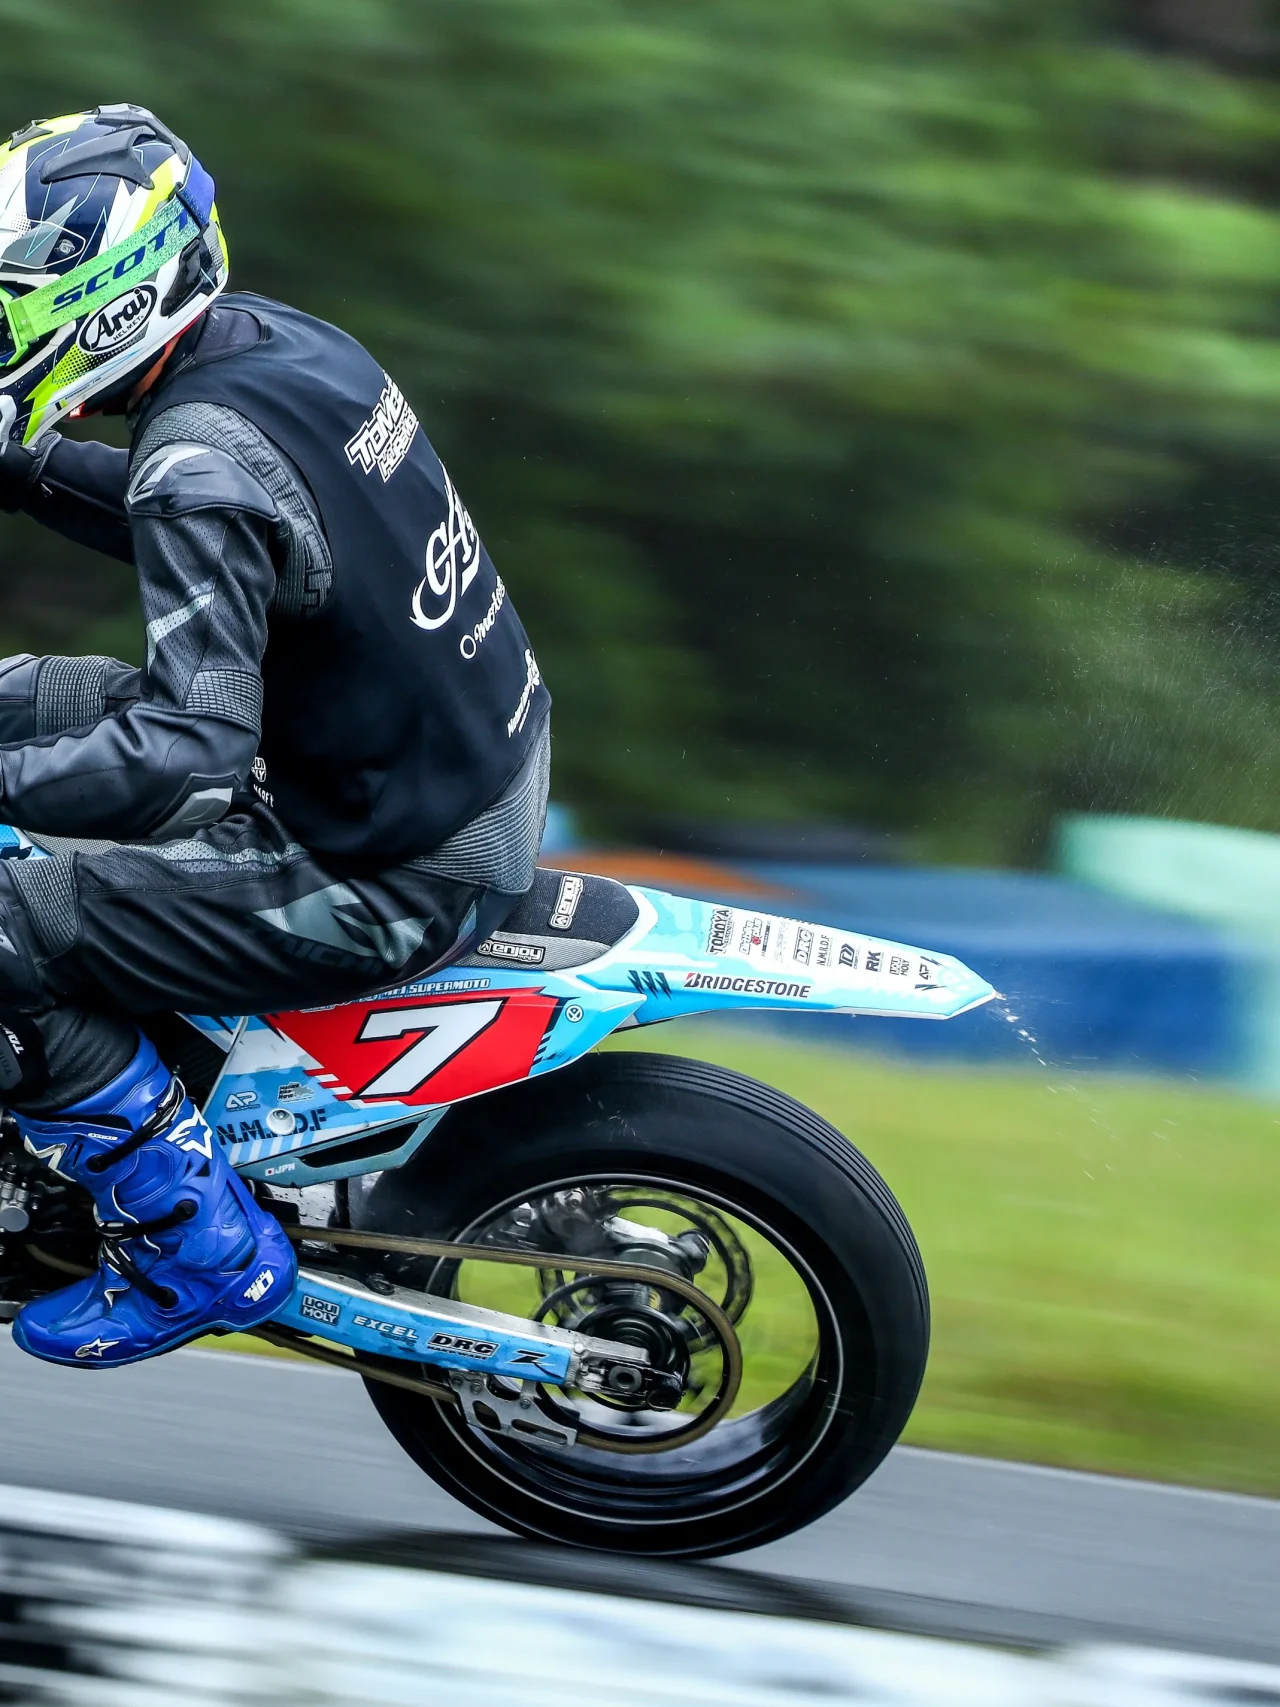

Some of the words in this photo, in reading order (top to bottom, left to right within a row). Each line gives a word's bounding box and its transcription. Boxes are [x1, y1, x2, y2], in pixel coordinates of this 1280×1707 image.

[51, 208, 189, 314] SCOTT
[89, 288, 149, 350] Arai
[112, 315, 143, 342] HELMET
[709, 908, 731, 954] TOMOYA
[492, 941, 542, 960] enjoy
[795, 928, 813, 964] DRC
[866, 951, 881, 972] RK
[409, 978, 491, 995] SUPERMOTO
[683, 972, 812, 999] BRIDGESTONE
[353, 997, 509, 1100] 7
[216, 1108, 328, 1146] N.M..D.F
[251, 1269, 275, 1302] 10
[302, 1308, 338, 1324] MOLY
[304, 1295, 340, 1317] LIQUI
[352, 1314, 419, 1340] EXCEL
[428, 1333, 500, 1358] DRC
